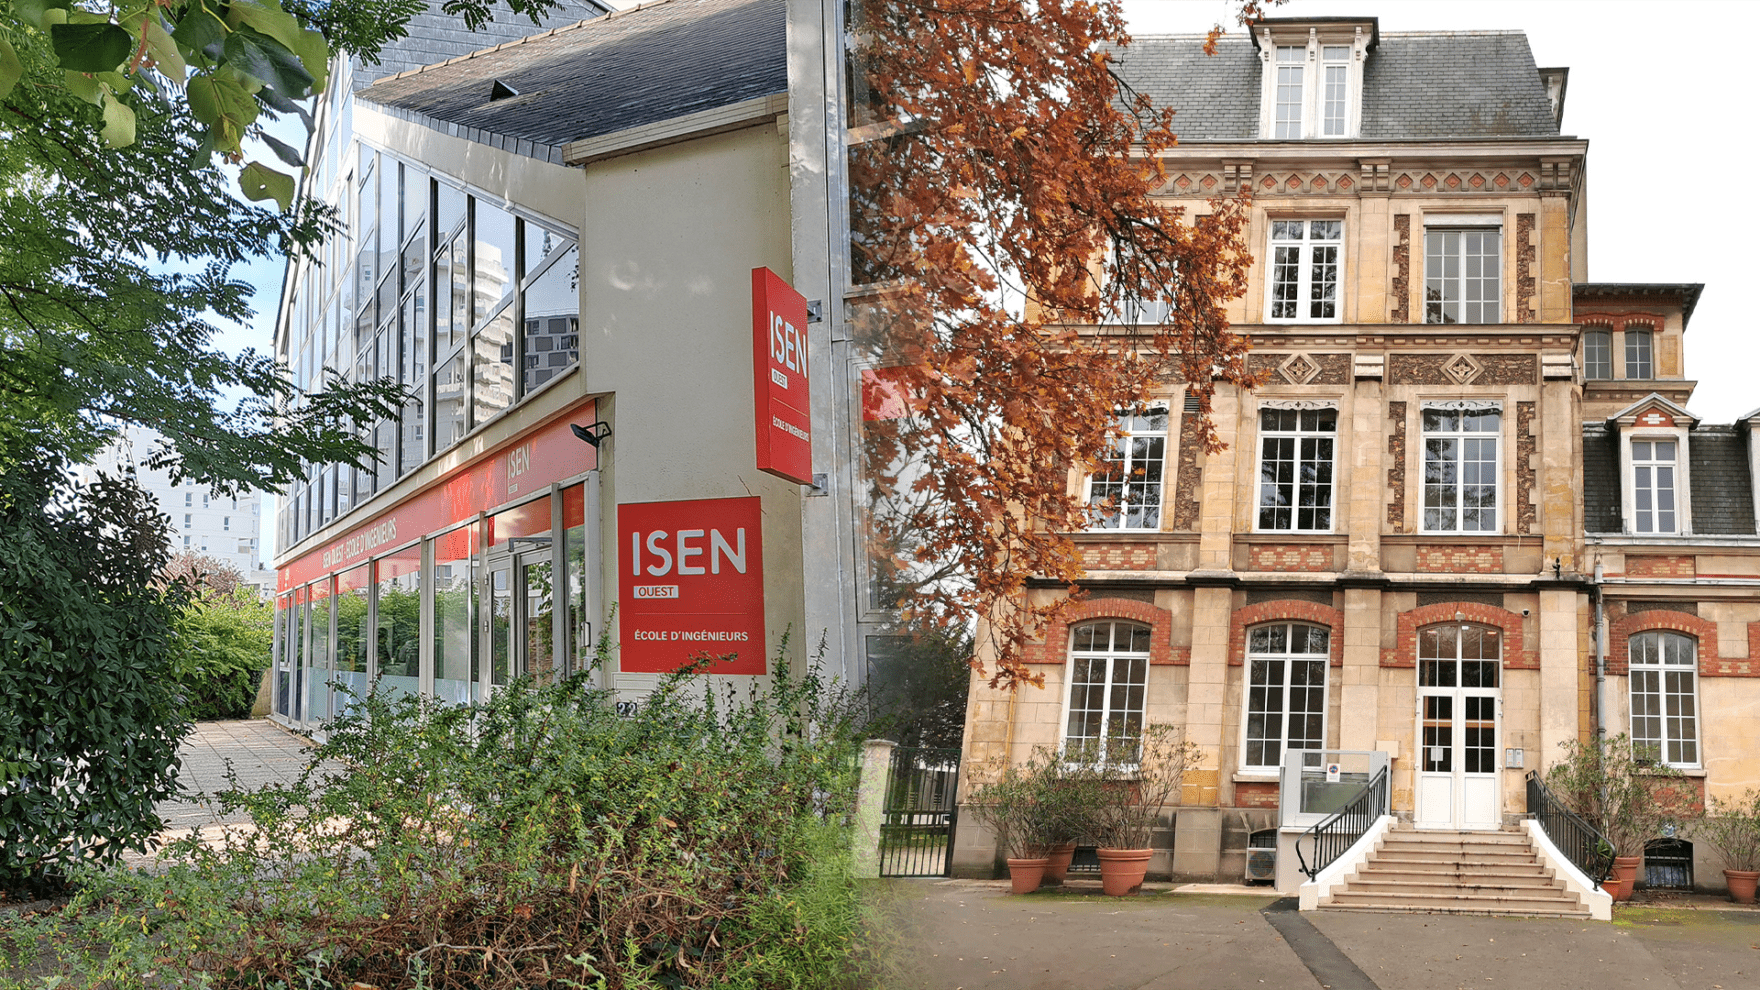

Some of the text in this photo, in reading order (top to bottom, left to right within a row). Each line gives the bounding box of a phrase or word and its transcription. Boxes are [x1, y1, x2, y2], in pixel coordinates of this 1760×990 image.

[770, 310, 807, 378] ISEN
[773, 370, 787, 387] OUEST
[773, 414, 785, 430] ÉCOLE
[508, 443, 530, 479] ISEN
[632, 527, 746, 576] ISEN
[638, 586, 674, 597] OUEST
[634, 629, 749, 642] ÉCOLE D'INGÉNIEURS
[617, 702, 636, 717] 22
